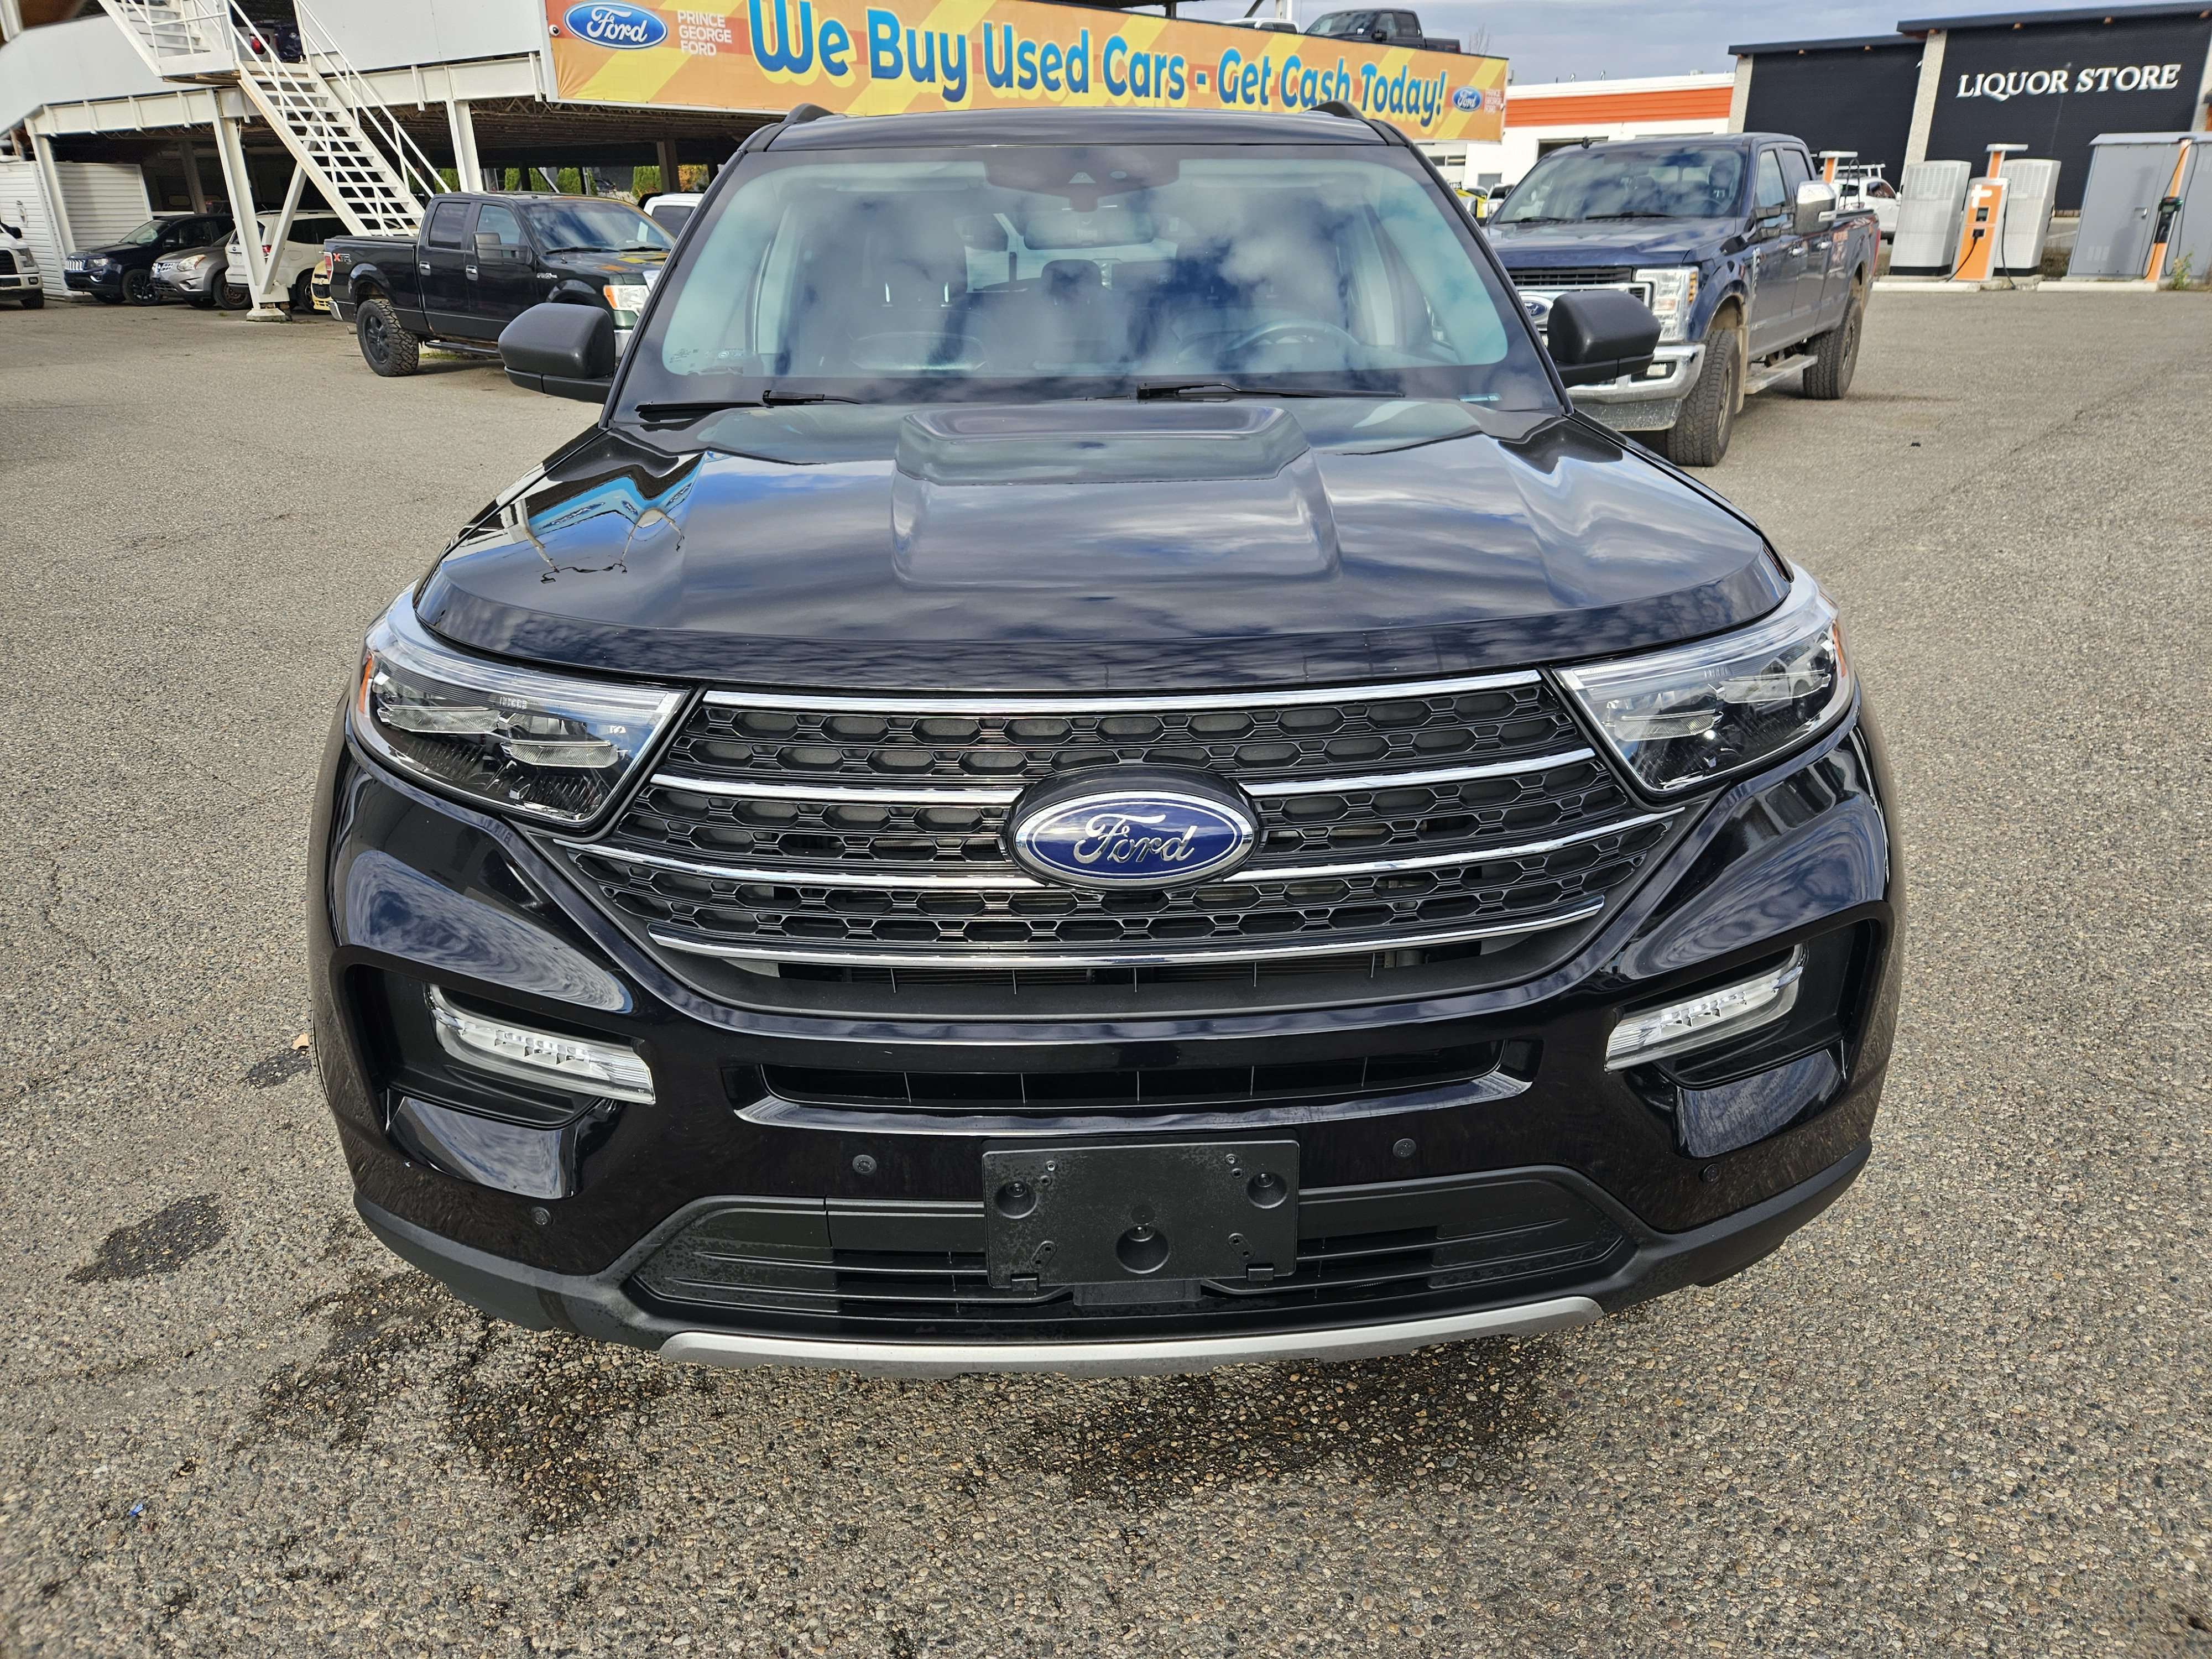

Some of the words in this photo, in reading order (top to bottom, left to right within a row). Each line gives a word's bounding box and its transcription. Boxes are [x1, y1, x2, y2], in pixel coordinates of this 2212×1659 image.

[586, 6, 649, 43] Ford
[677, 9, 726, 28] PRINCE
[678, 24, 732, 44] GEORGE
[680, 40, 717, 56] FORD
[748, 0, 849, 76] We
[867, 8, 967, 103] Buy
[983, 22, 1089, 94] Used
[1103, 35, 1185, 100] Cars
[1217, 48, 1271, 106] Get
[1280, 55, 1352, 108] Cash
[1360, 62, 1447, 128] Today!
[1955, 70, 2069, 102] LIQUOR
[2074, 64, 2182, 94] STORE
[332, 253, 352, 263] XTR
[1073, 813, 1197, 864] Ford
